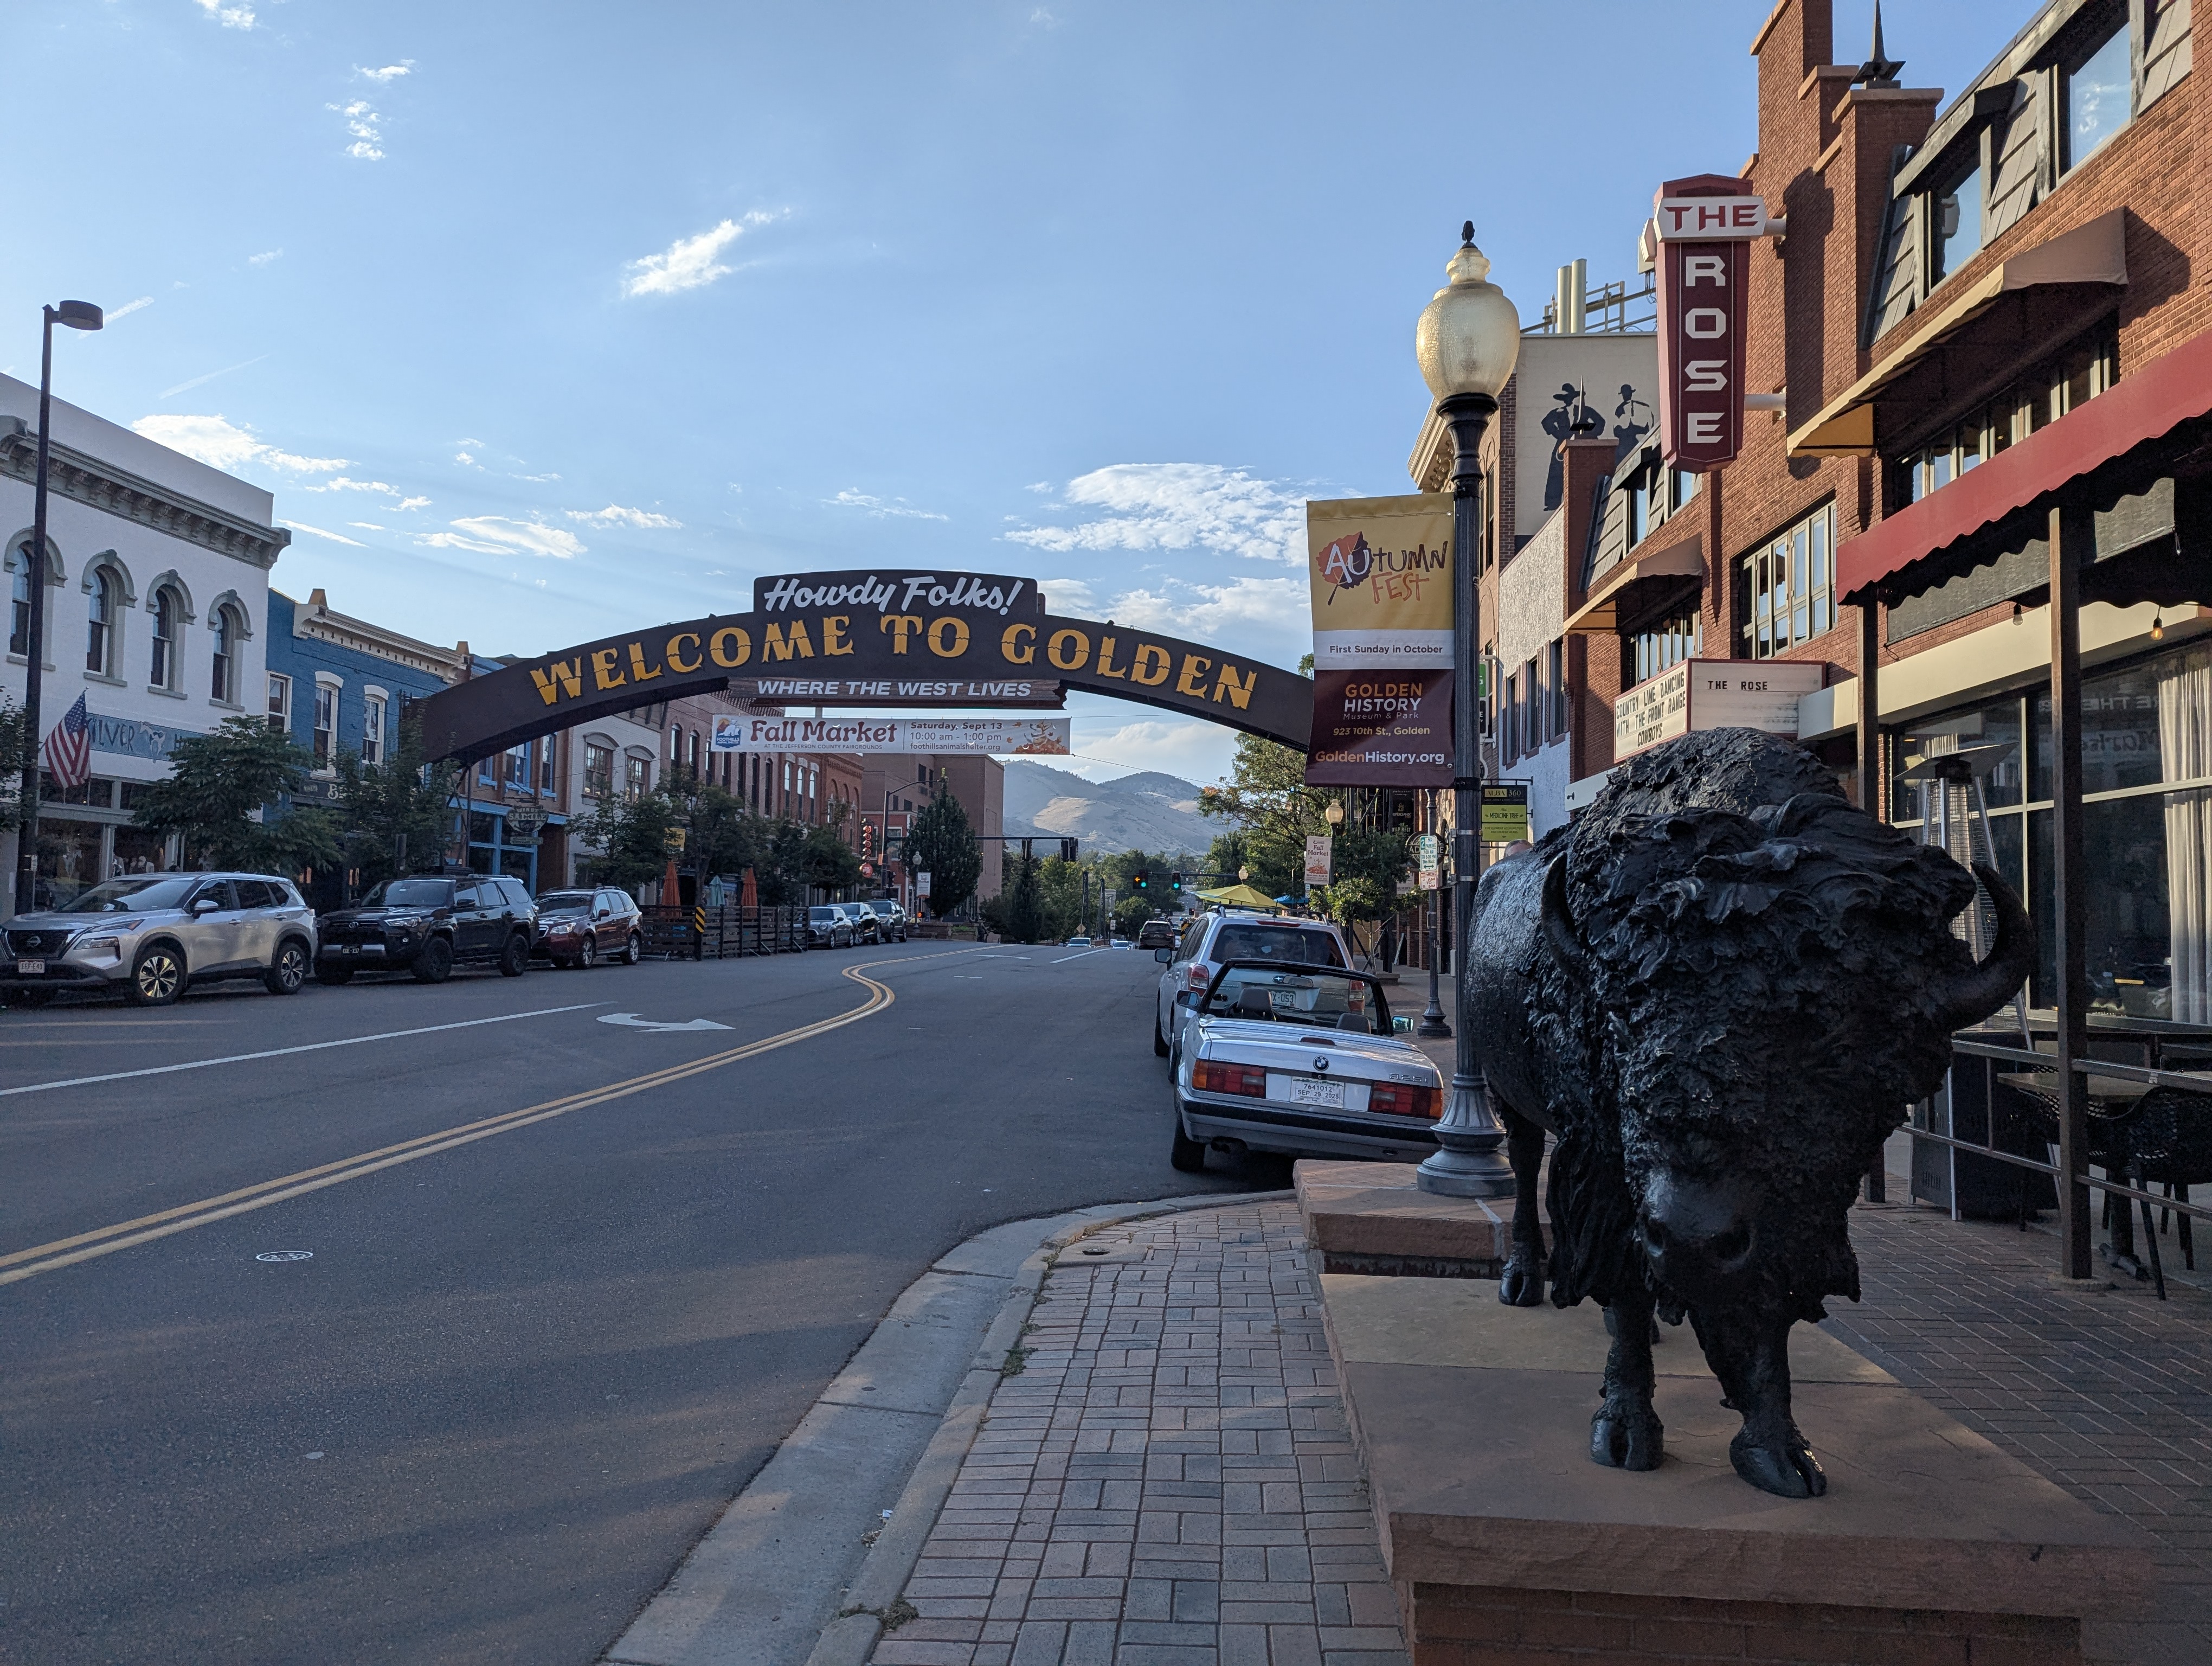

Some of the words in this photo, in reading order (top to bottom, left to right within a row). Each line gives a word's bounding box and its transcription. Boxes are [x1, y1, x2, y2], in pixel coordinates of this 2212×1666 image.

[1664, 204, 1760, 232] THE
[1684, 255, 1728, 444] ROSE
[764, 575, 897, 613] Howdy
[901, 575, 1025, 616] Folks!
[1329, 645, 1352, 654] First
[1354, 645, 1390, 656] Sunday
[1392, 645, 1401, 653] in
[1404, 644, 1443, 654] October
[529, 614, 856, 706] WELCOME
[880, 614, 970, 658] TO
[1001, 623, 1257, 710] GOLDEN
[757, 680, 839, 695] WHERE
[846, 681, 892, 695] THE
[898, 681, 964, 696] WEST
[967, 682, 1032, 697] LIVES
[1345, 683, 1423, 698] GOLDEN
[1707, 680, 1727, 691] THE
[1741, 681, 1768, 691] ROSE
[1616, 695, 1639, 720] COUNTRY
[1643, 686, 1656, 707] LINE
[1660, 671, 1684, 699] DANCING
[1344, 697, 1422, 713] HISTORY
[1343, 712, 1381, 721] Museum
[1386, 712, 1392, 720] &
[1396, 712, 1419, 720] Park
[1616, 719, 1629, 738] WITH
[1635, 711, 1645, 730] THE
[1648, 701, 1665, 724] FRONT
[1668, 690, 1686, 715] RANGE
[750, 720, 797, 742] Fall
[801, 720, 898, 742] Market
[910, 722, 959, 731] Saturday,
[962, 722, 986, 731] Sept
[1333, 727, 1351, 736] 923
[1353, 727, 1373, 736] 10th
[1375, 727, 1391, 737] St.,
[1394, 726, 1431, 736] Golden
[910, 732, 936, 740] 10:00
[987, 734, 1002, 743] pm
[1637, 722, 1663, 747] COWBOYS
[910, 743, 1001, 752] foothillsanimalshelter.org
[1315, 750, 1445, 765] GoldenHistory.org
[1421, 839, 1425, 848] 2
[1303, 1083, 1333, 1092] 7641012
